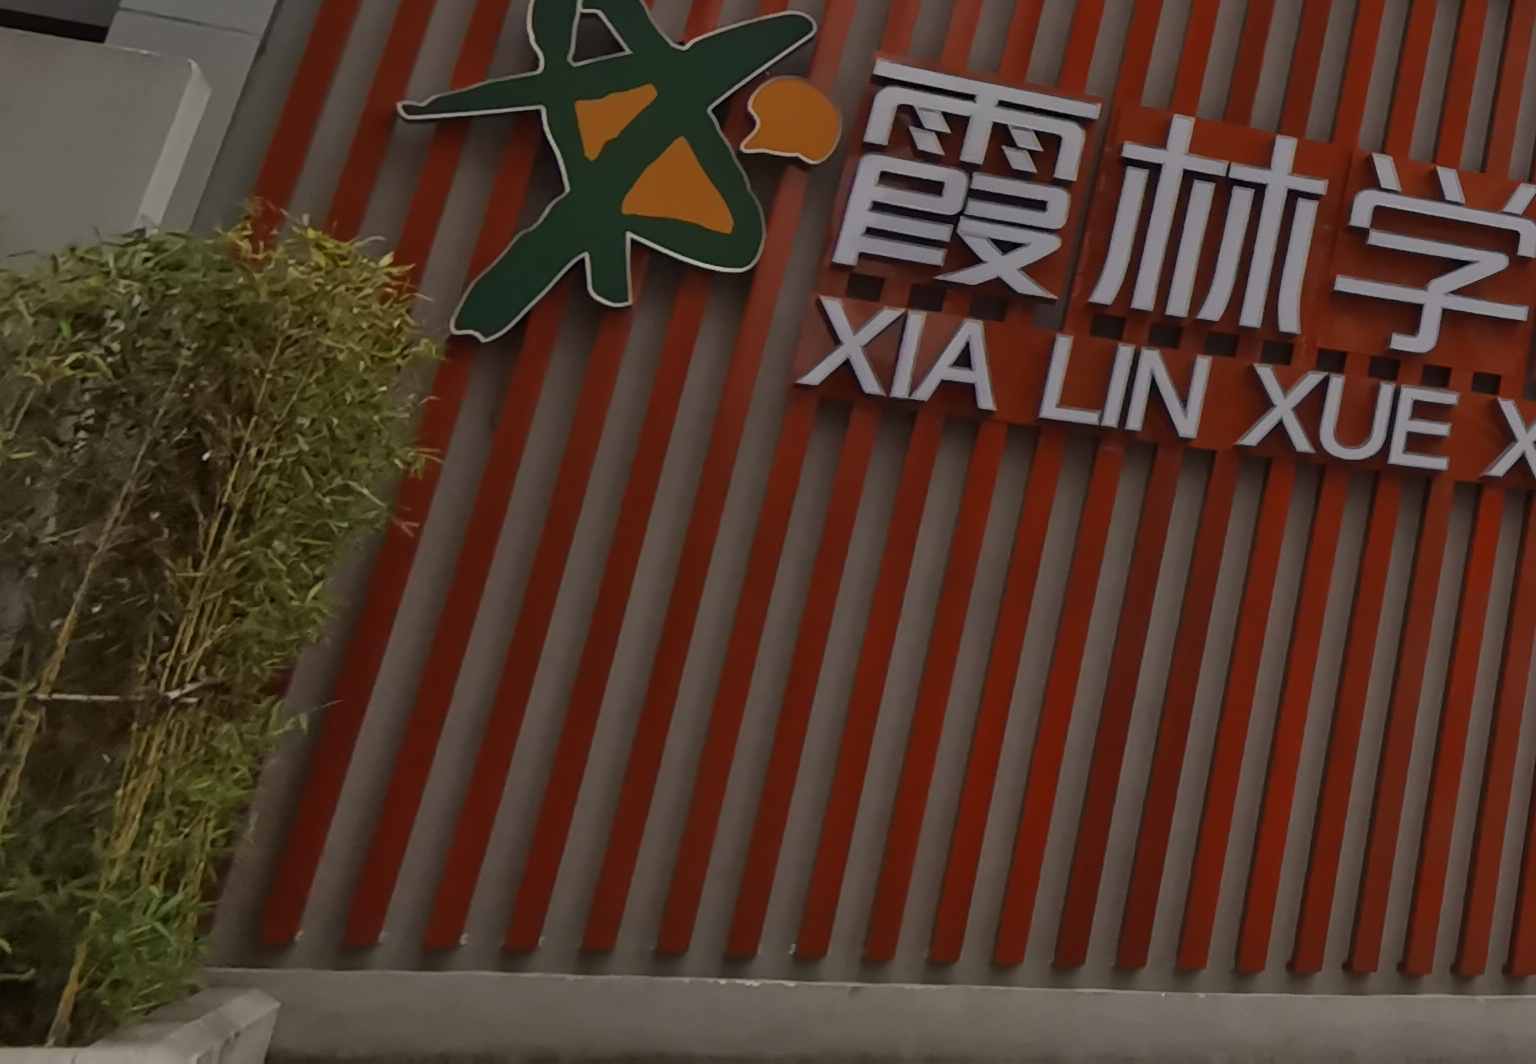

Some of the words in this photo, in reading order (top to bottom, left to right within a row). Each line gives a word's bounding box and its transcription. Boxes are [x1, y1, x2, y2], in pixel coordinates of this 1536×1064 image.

[798, 298, 996, 411] XIA
[1040, 335, 1210, 439] LIN
[1238, 365, 1459, 471] XUE
